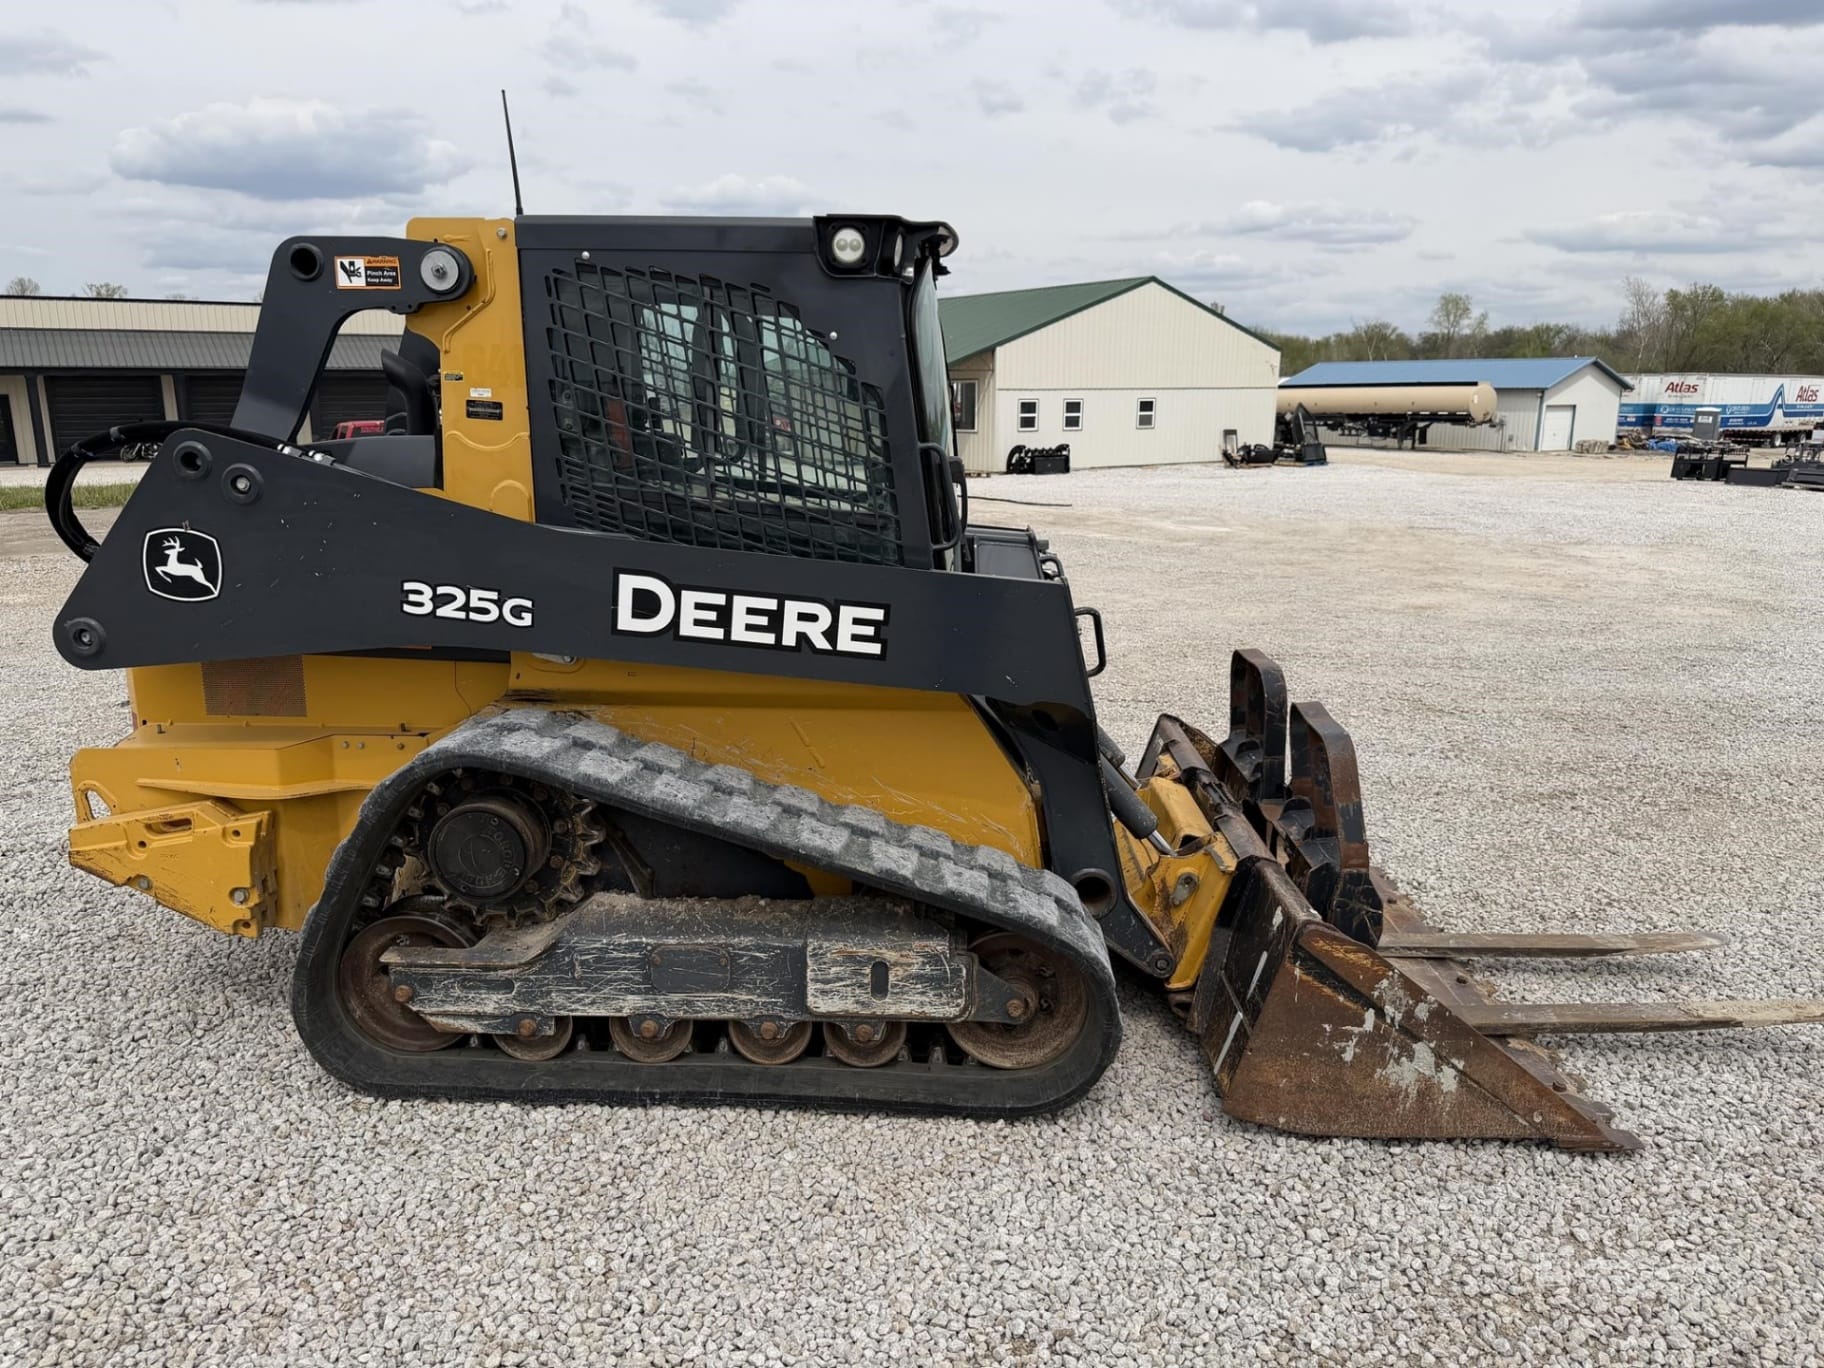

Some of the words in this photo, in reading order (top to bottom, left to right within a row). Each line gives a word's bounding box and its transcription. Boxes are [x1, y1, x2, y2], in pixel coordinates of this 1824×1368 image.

[1665, 381, 1699, 393] Atlas
[1796, 385, 1819, 402] Atlas
[402, 581, 533, 628] 325G
[616, 573, 885, 655] DEERE
